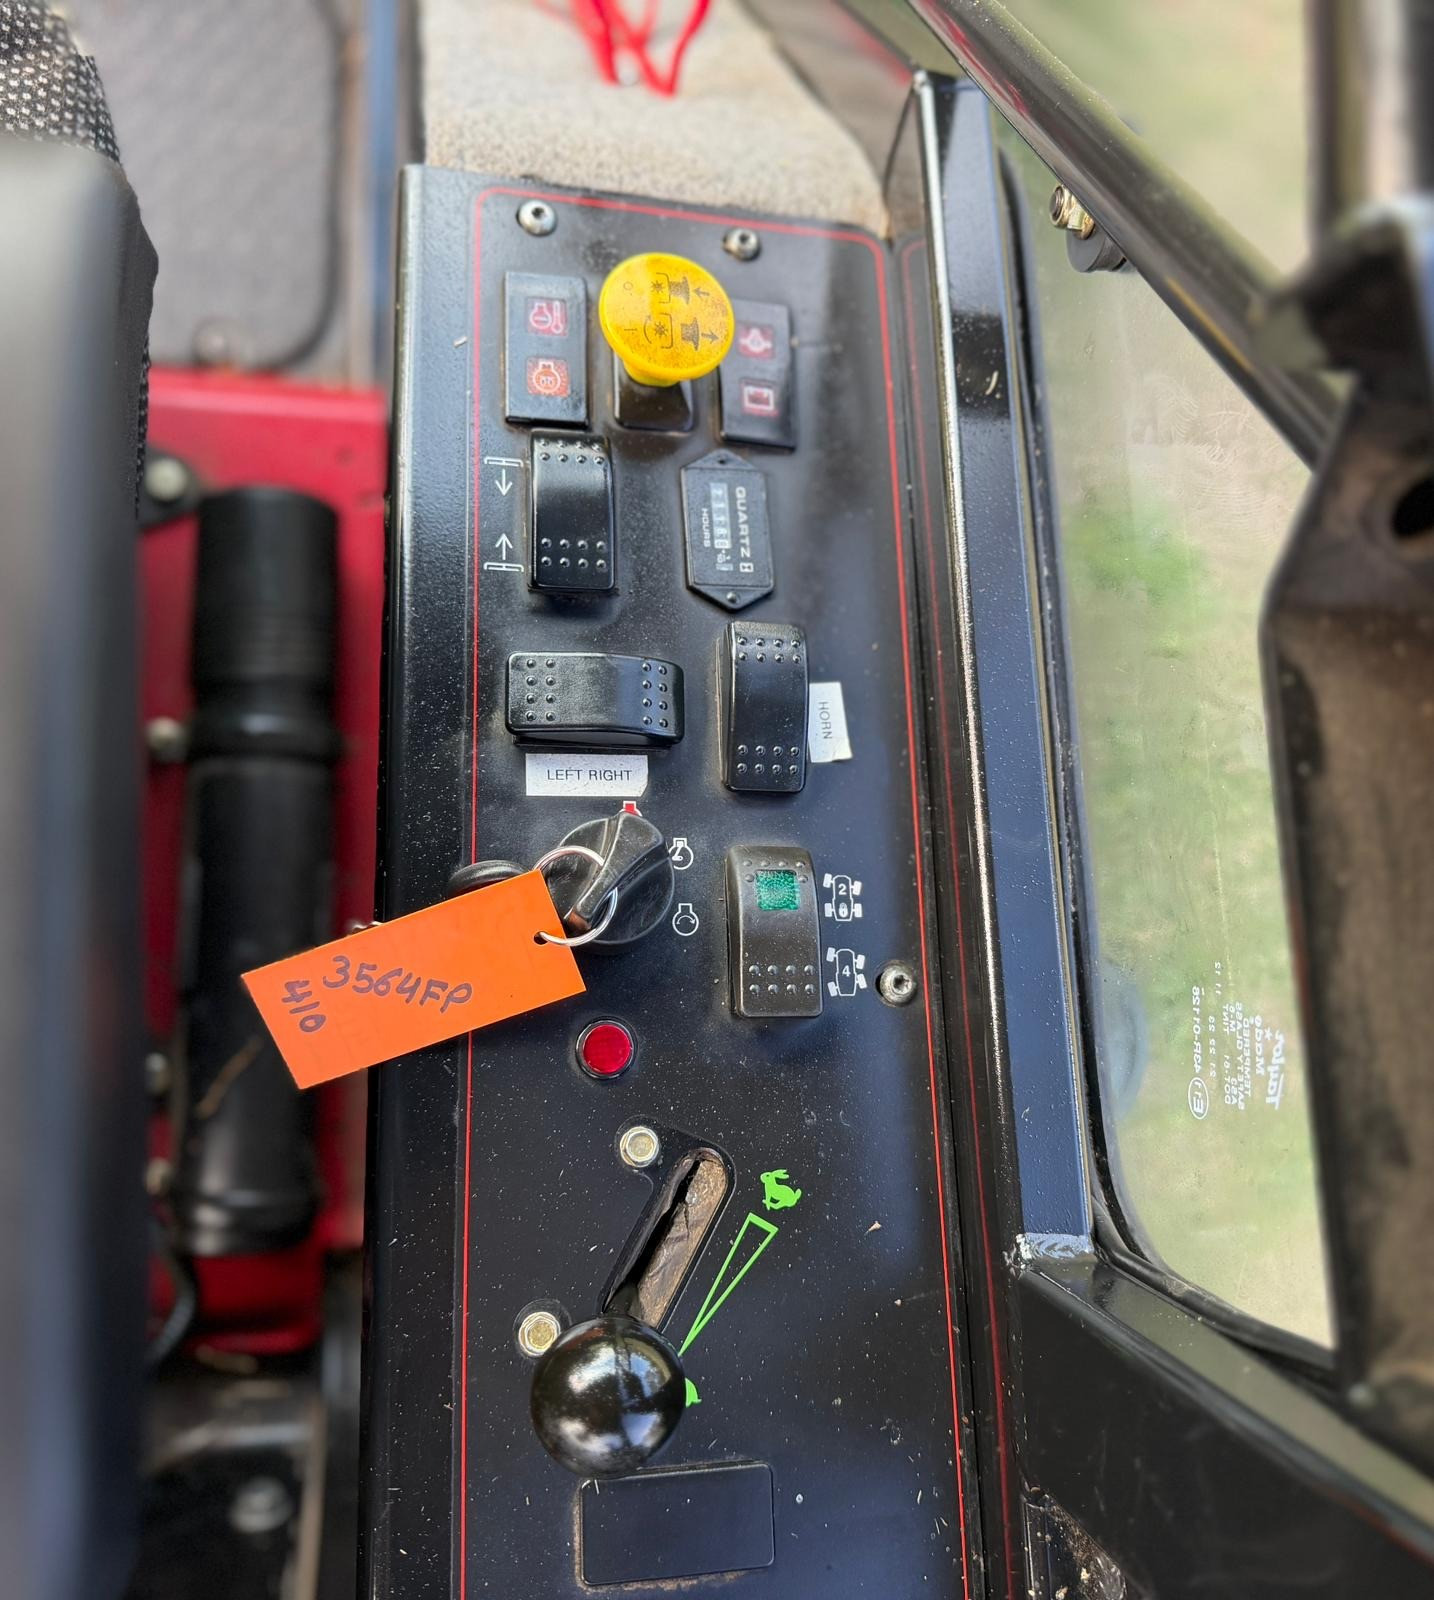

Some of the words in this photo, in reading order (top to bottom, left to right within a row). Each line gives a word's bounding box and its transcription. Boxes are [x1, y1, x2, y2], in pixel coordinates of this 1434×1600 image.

[701, 507, 711, 548] HOURS
[735, 486, 751, 558] QUARTZ
[818, 700, 833, 740] HORN
[547, 769, 583, 781] LEFT
[589, 769, 633, 781] RIGHT
[838, 883, 847, 895] 2
[322, 955, 473, 1013] 3564FP
[842, 965, 851, 977] 4
[282, 979, 327, 1033] 410
